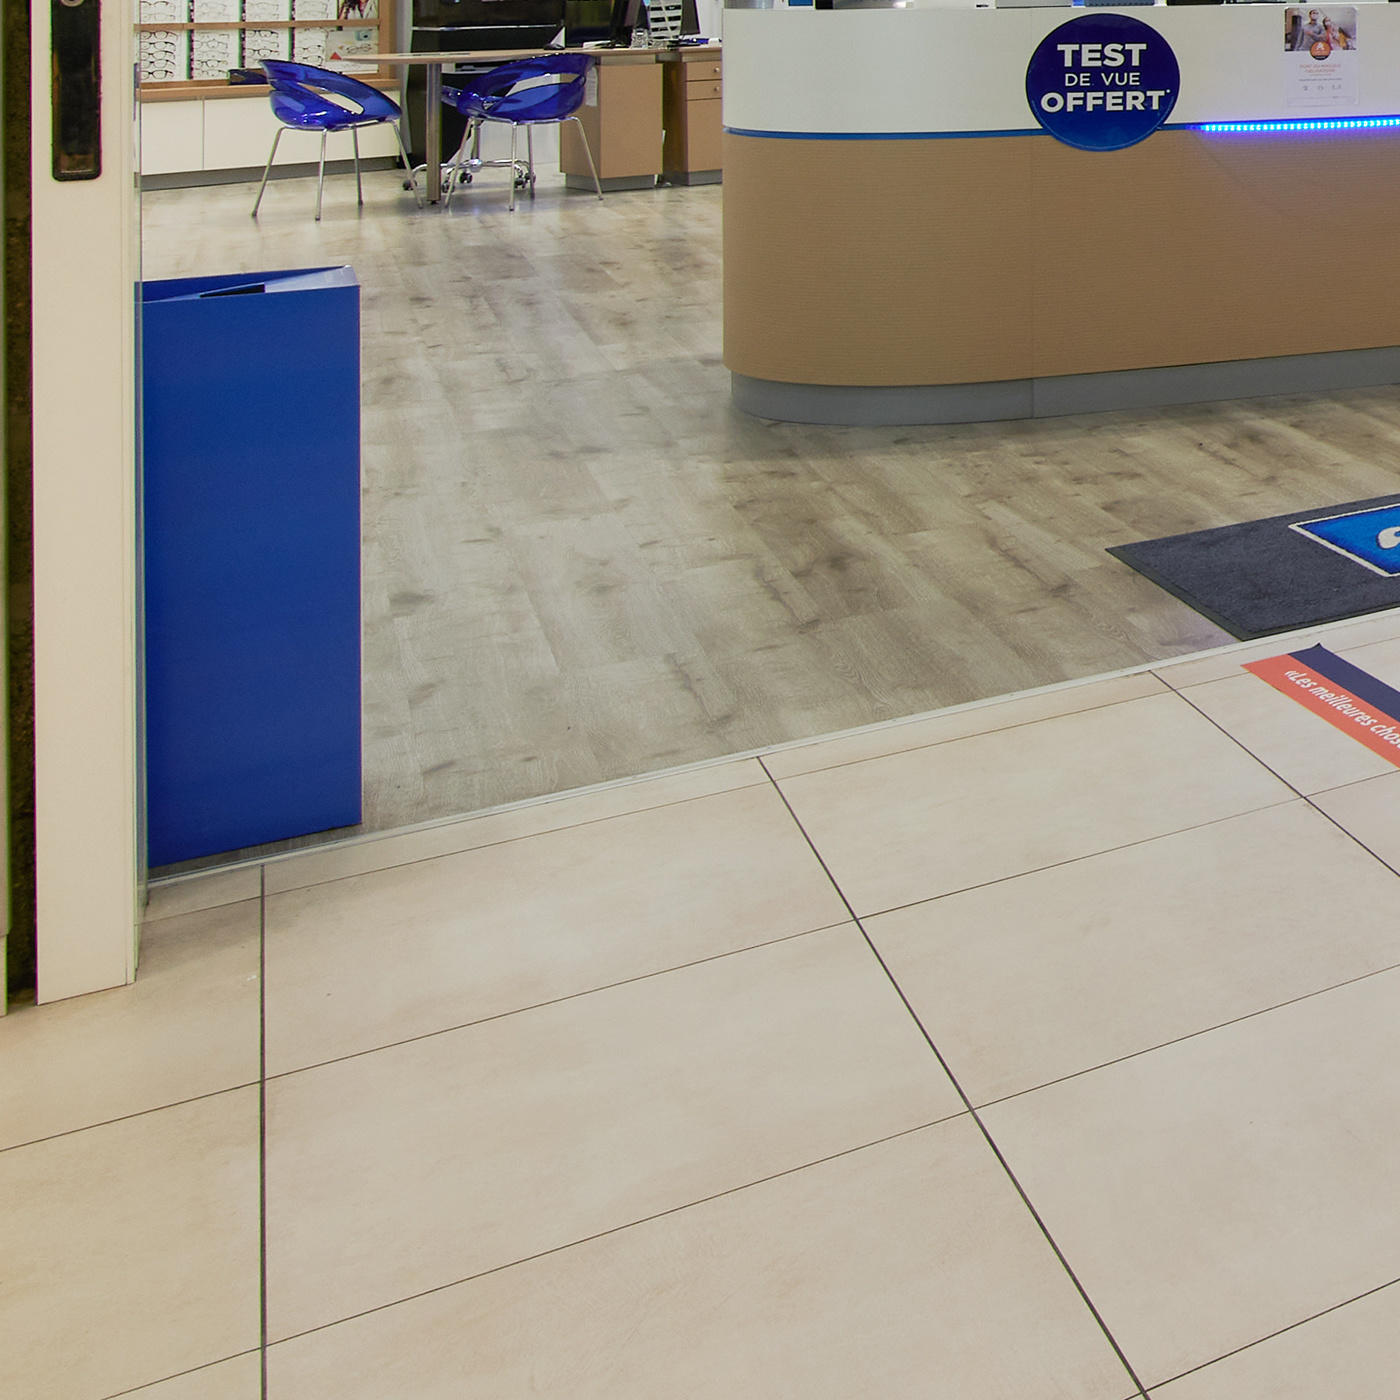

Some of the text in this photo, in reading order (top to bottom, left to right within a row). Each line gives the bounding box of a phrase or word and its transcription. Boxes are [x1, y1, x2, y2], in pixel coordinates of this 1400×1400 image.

[1057, 43, 1147, 67] TEST
[1065, 72, 1141, 86] DE VUE
[1308, 686, 1378, 726] meilleures
